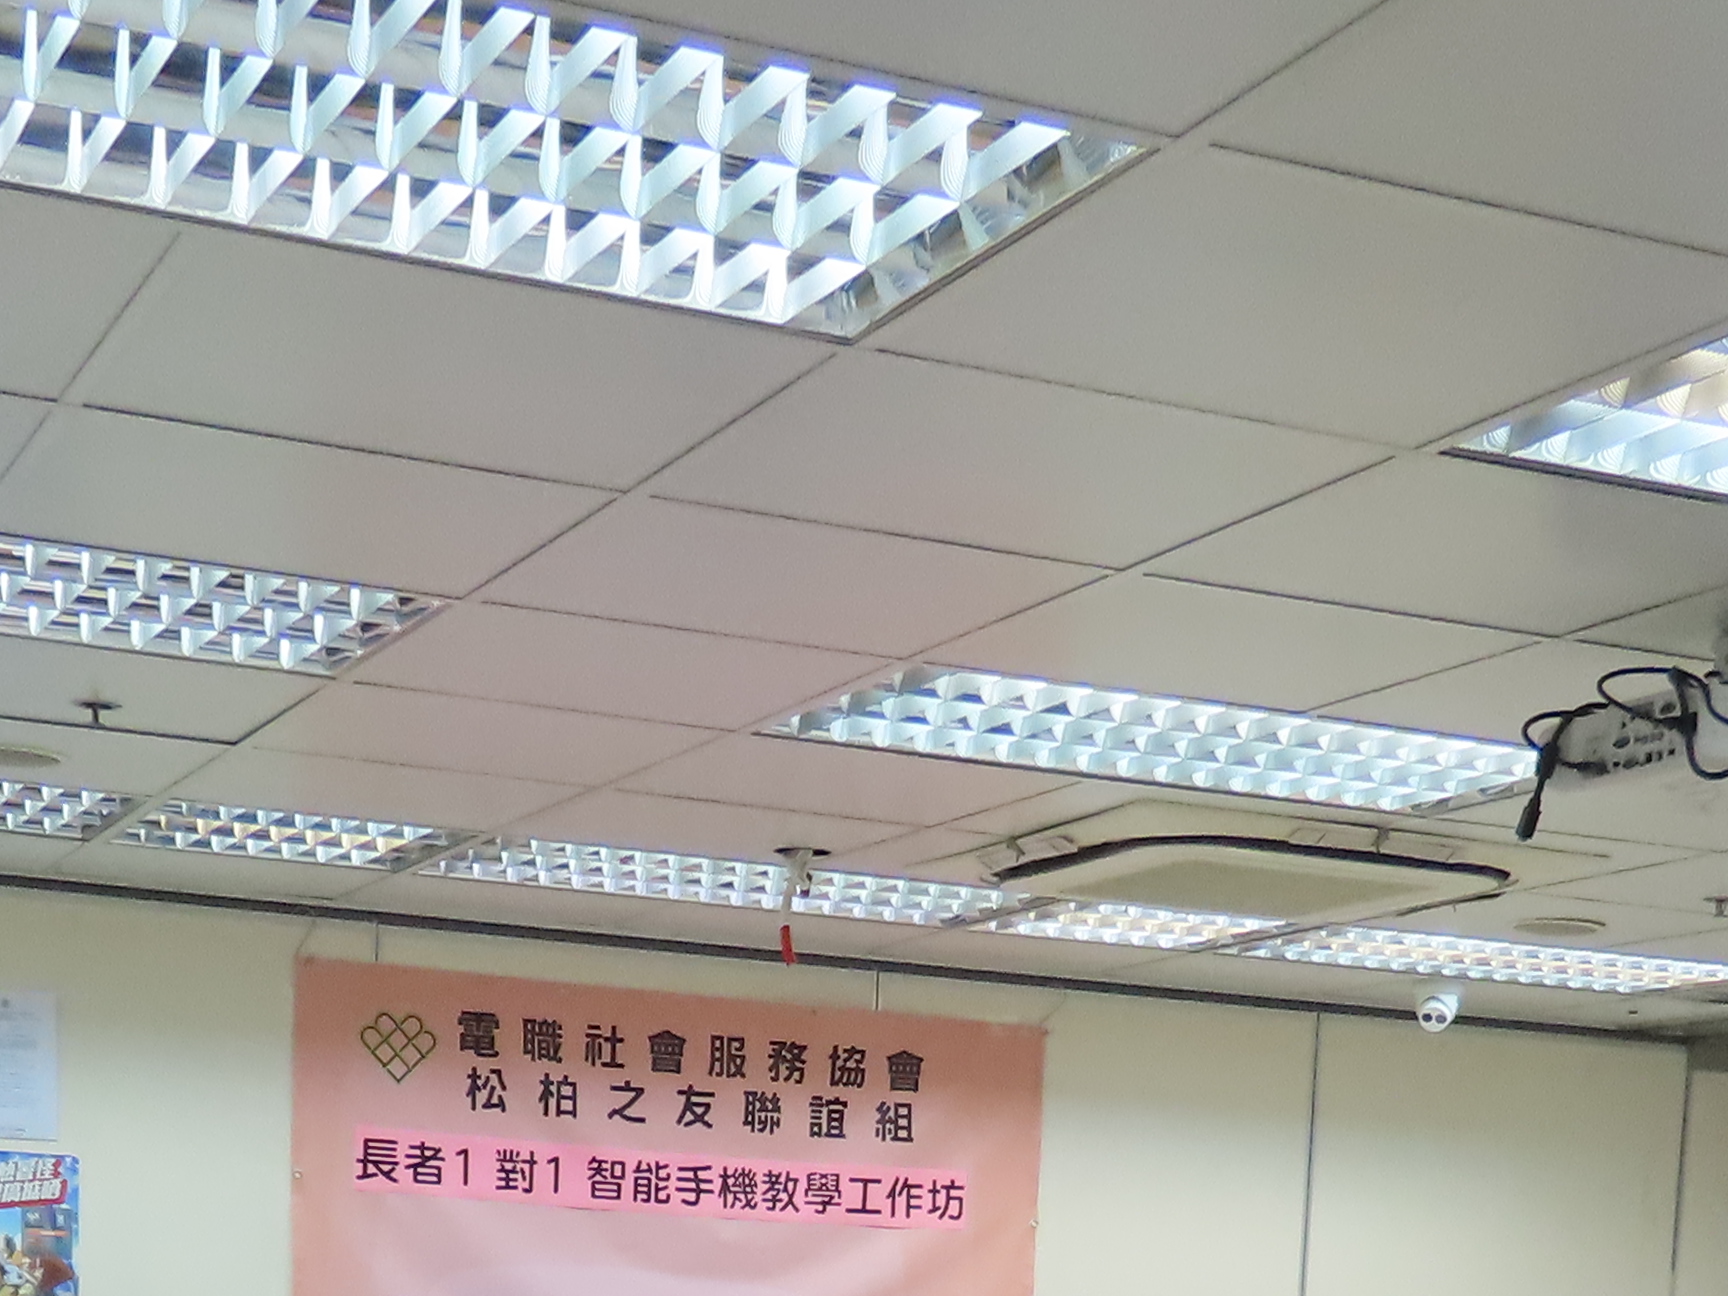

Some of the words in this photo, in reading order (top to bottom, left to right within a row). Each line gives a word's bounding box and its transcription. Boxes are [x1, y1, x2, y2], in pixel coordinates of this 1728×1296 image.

[457, 1011, 925, 1094] 電職社會服務協會
[466, 1067, 915, 1144] 松柏之友聯誼組
